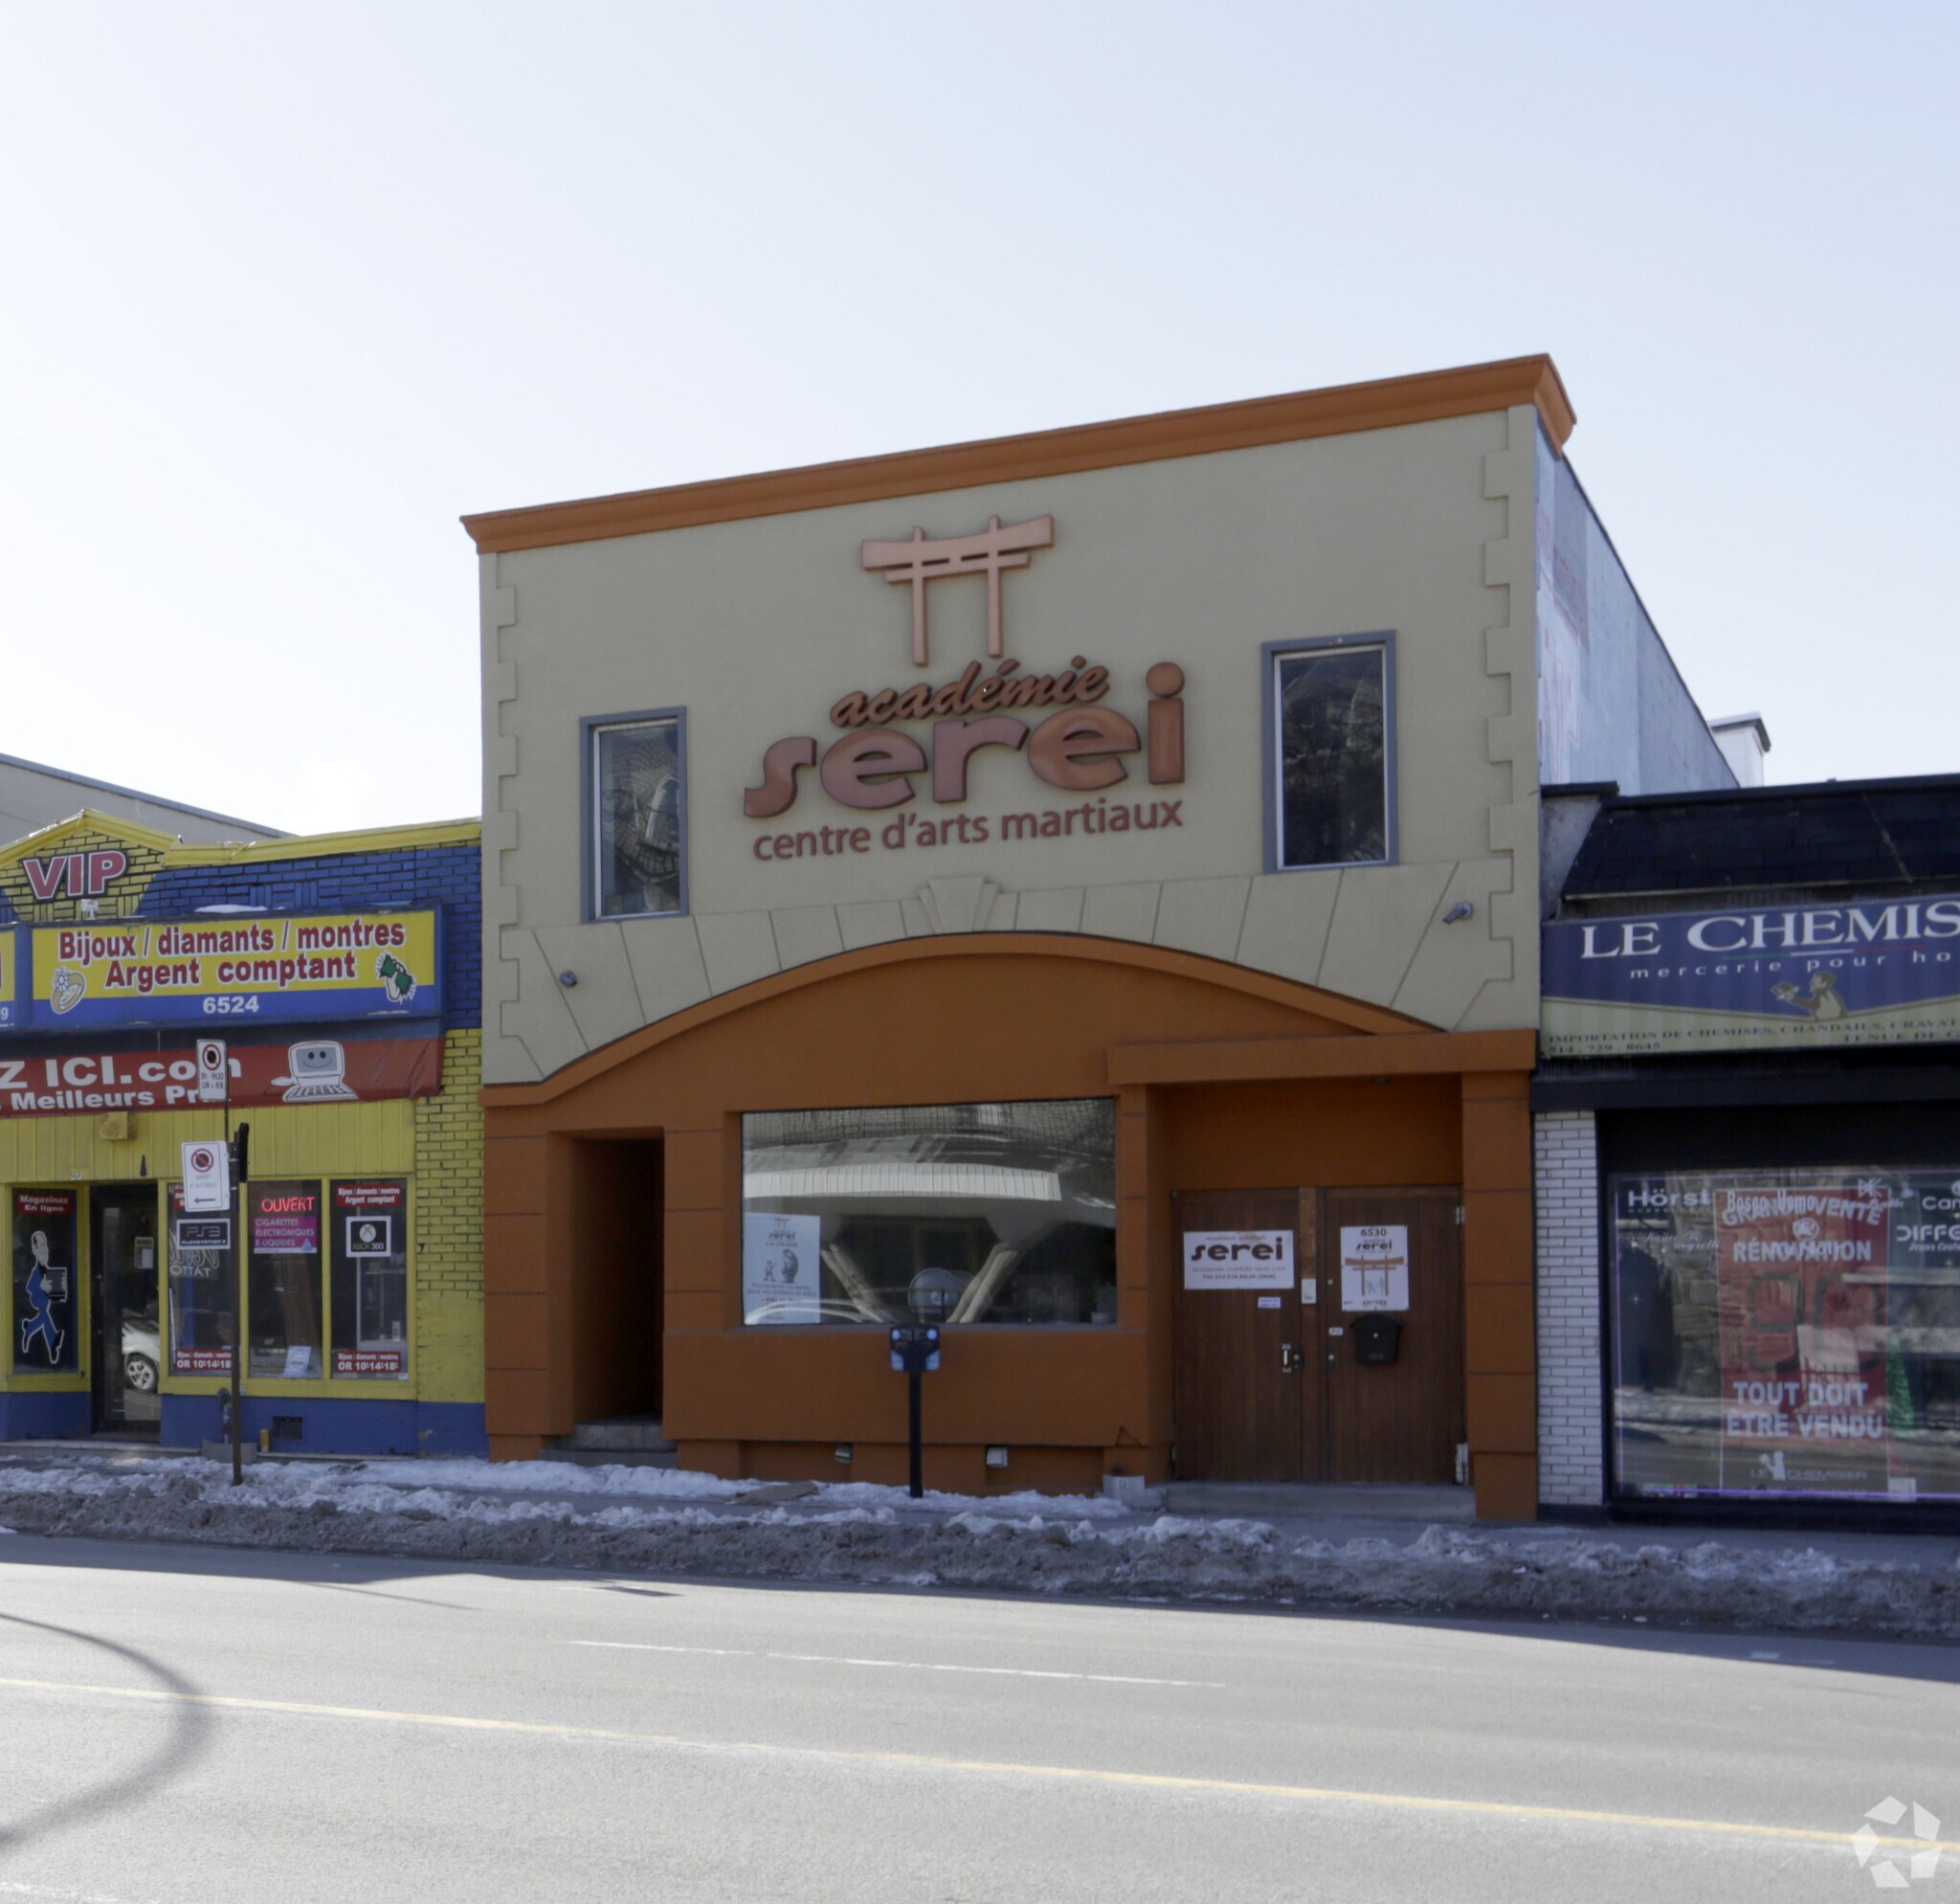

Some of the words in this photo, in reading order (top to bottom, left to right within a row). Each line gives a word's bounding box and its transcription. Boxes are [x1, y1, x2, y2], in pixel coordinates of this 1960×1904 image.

[830, 655, 1110, 728] académie
[744, 661, 1186, 818] serei
[753, 820, 871, 862] centre
[882, 812, 990, 850] d'arts
[1001, 797, 1184, 841] martiaux
[23, 850, 126, 900] VIP
[1580, 922, 1660, 959] LE
[1687, 901, 1960, 952] CHEMIS
[59, 930, 136, 965] Bijoux
[158, 924, 275, 955] diamants
[298, 919, 405, 950] montres
[105, 957, 200, 993] Argent
[218, 951, 355, 987] comptant
[1631, 960, 1782, 979] mercerie
[1807, 955, 1886, 974] pour
[203, 996, 259, 1015] 6524
[1549, 1030, 1658, 1042] IMPORTATION
[1662, 1030, 1682, 1039] DE
[11, 1089, 155, 1110] Meilleurs
[20, 1195, 68, 1204] Magasinez
[40, 1204, 64, 1213] ligne
[261, 1196, 315, 1212] OUVERT
[1628, 1189, 1711, 1207] Hörst
[255, 1218, 300, 1226] CIGARETTES
[1815, 1196, 1883, 1226] VENTE
[187, 1226, 221, 1237] PS3
[1361, 1227, 1387, 1237] 6530
[1191, 1236, 1282, 1261] serei
[177, 1360, 190, 1369] OR
[338, 1362, 353, 1371] OR
[1733, 1381, 1800, 1407] TOUT
[1809, 1381, 1868, 1407] DOIT
[1726, 1408, 1790, 1437] ÊTRE
[1796, 1412, 1883, 1440] VENDU
